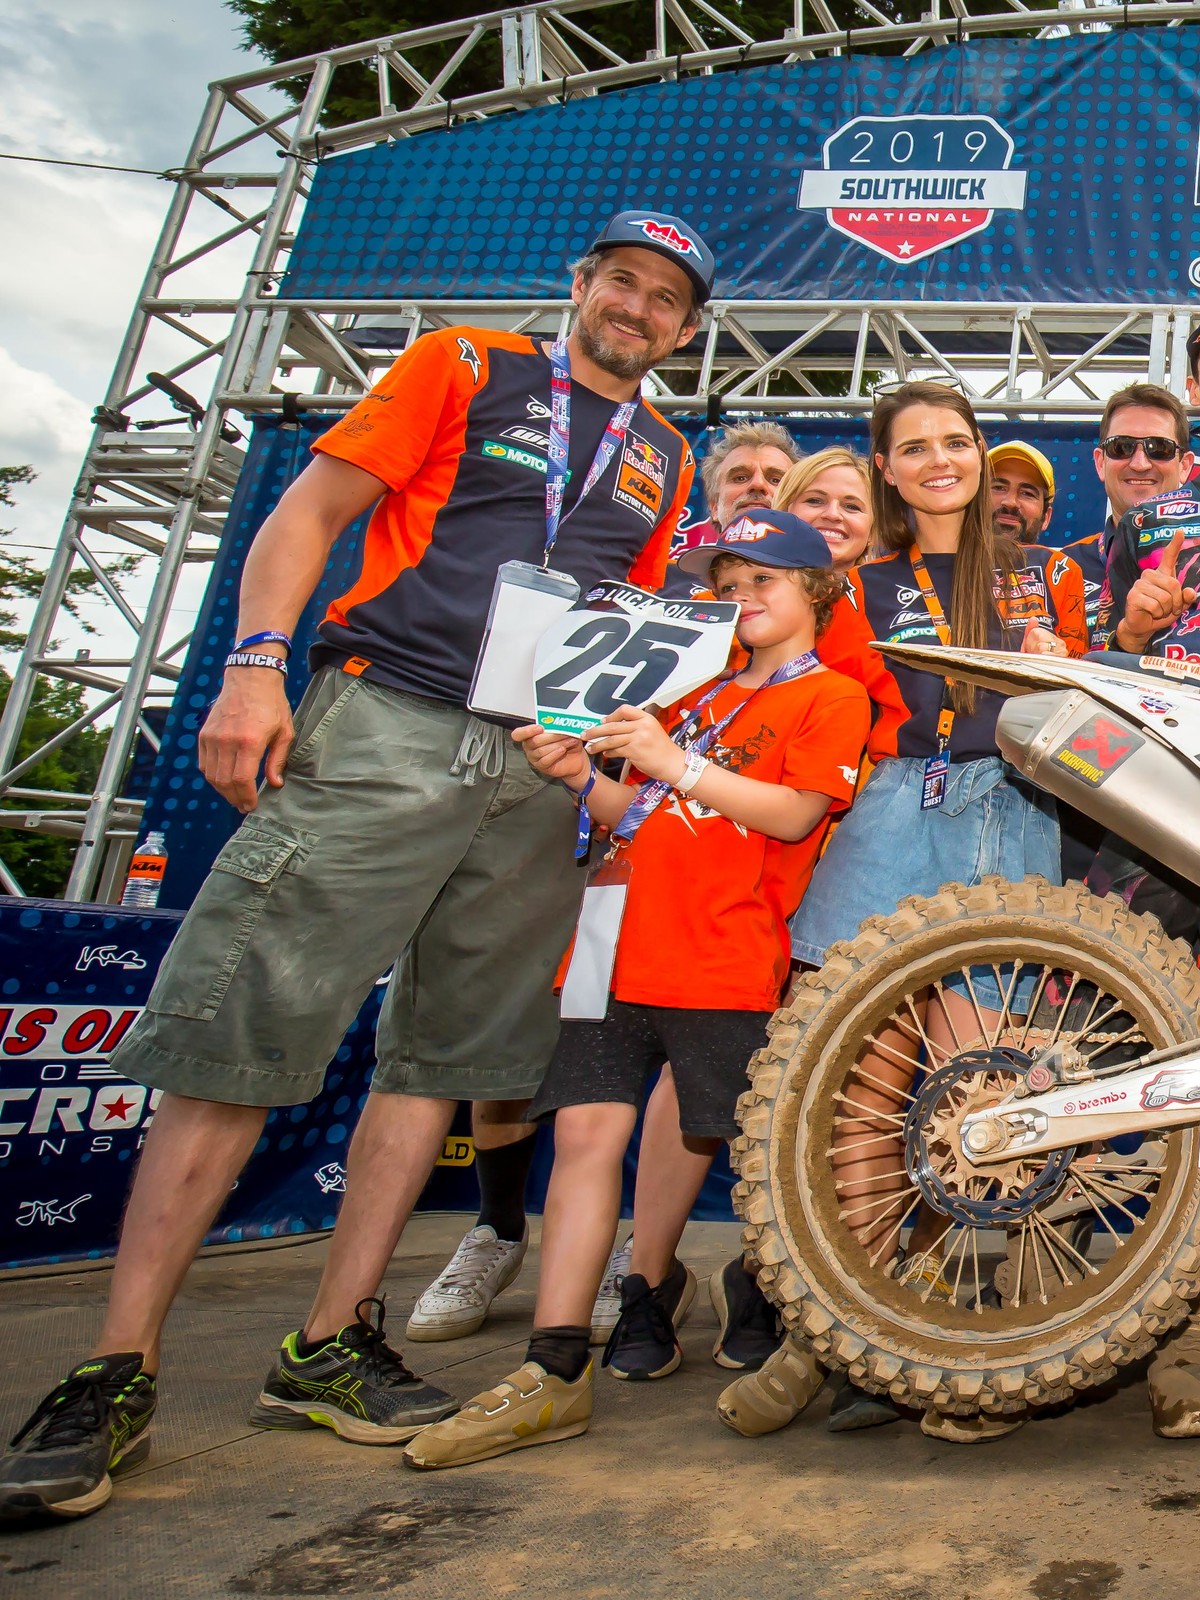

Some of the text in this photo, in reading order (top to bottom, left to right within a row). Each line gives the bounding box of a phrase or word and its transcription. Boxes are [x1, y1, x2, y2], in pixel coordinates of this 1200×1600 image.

[849, 131, 987, 163] 2019
[839, 178, 986, 200] SOUTHWICK
[848, 212, 972, 222] NATIONAL
[507, 449, 547, 473] MOTO
[624, 448, 665, 487] Red Bull
[627, 477, 657, 503] KTM
[617, 490, 642, 511] FACTORY
[1162, 503, 1196, 515] 100%
[1021, 583, 1045, 598] Bull
[663, 604, 693, 620] OIL
[536, 616, 704, 715] 25
[1142, 656, 1164, 667] SELLE
[1166, 660, 1189, 673] DALLA
[553, 715, 598, 731] MOTOREX
[923, 795, 943, 808] GUEST
[132, 861, 163, 873] KTM
[1078, 1090, 1127, 1111] brembo
